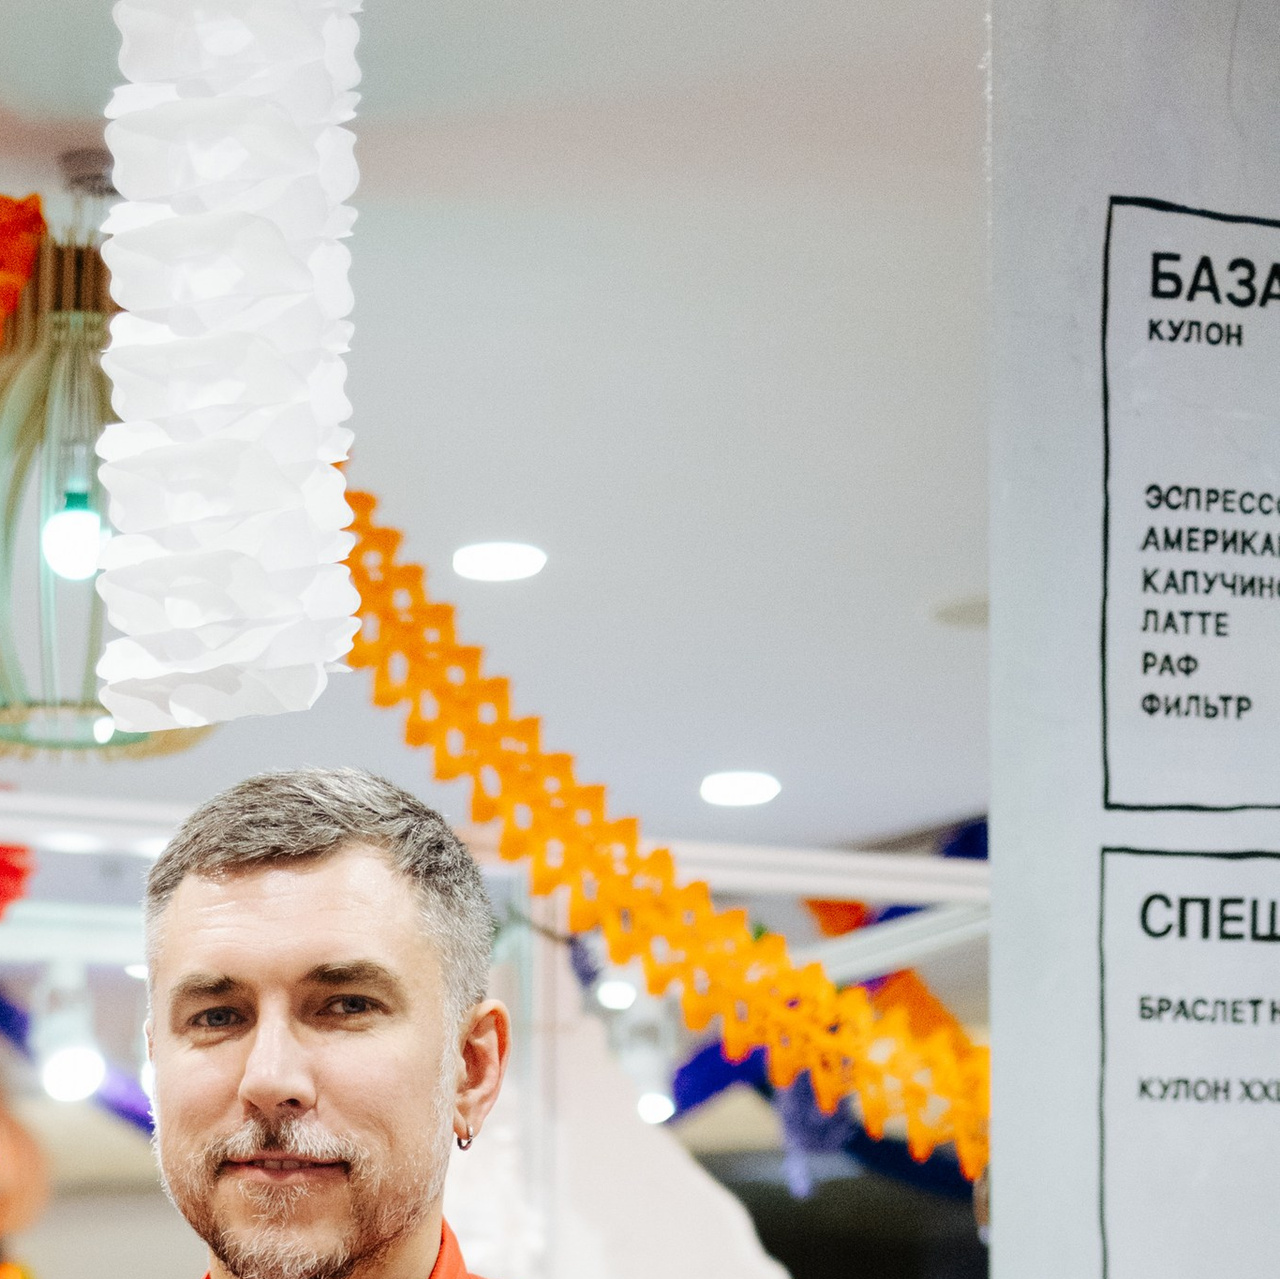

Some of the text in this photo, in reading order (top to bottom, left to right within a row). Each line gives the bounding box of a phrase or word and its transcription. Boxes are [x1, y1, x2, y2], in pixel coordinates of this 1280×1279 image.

[1148, 319, 1244, 346] КУЛОН
[1145, 484, 1280, 515] ЭСПРЕСС
[1141, 526, 1280, 557] АМЕРИКА
[1142, 567, 1280, 599] КАПУЧИН
[1142, 609, 1229, 636] ЛАТТЕ
[1142, 651, 1198, 676] РАФ
[1141, 693, 1252, 719] ФИЛЬТР
[1140, 997, 1263, 1024] БРАСЛЕТ
[1139, 1079, 1231, 1102] КУЛОН
